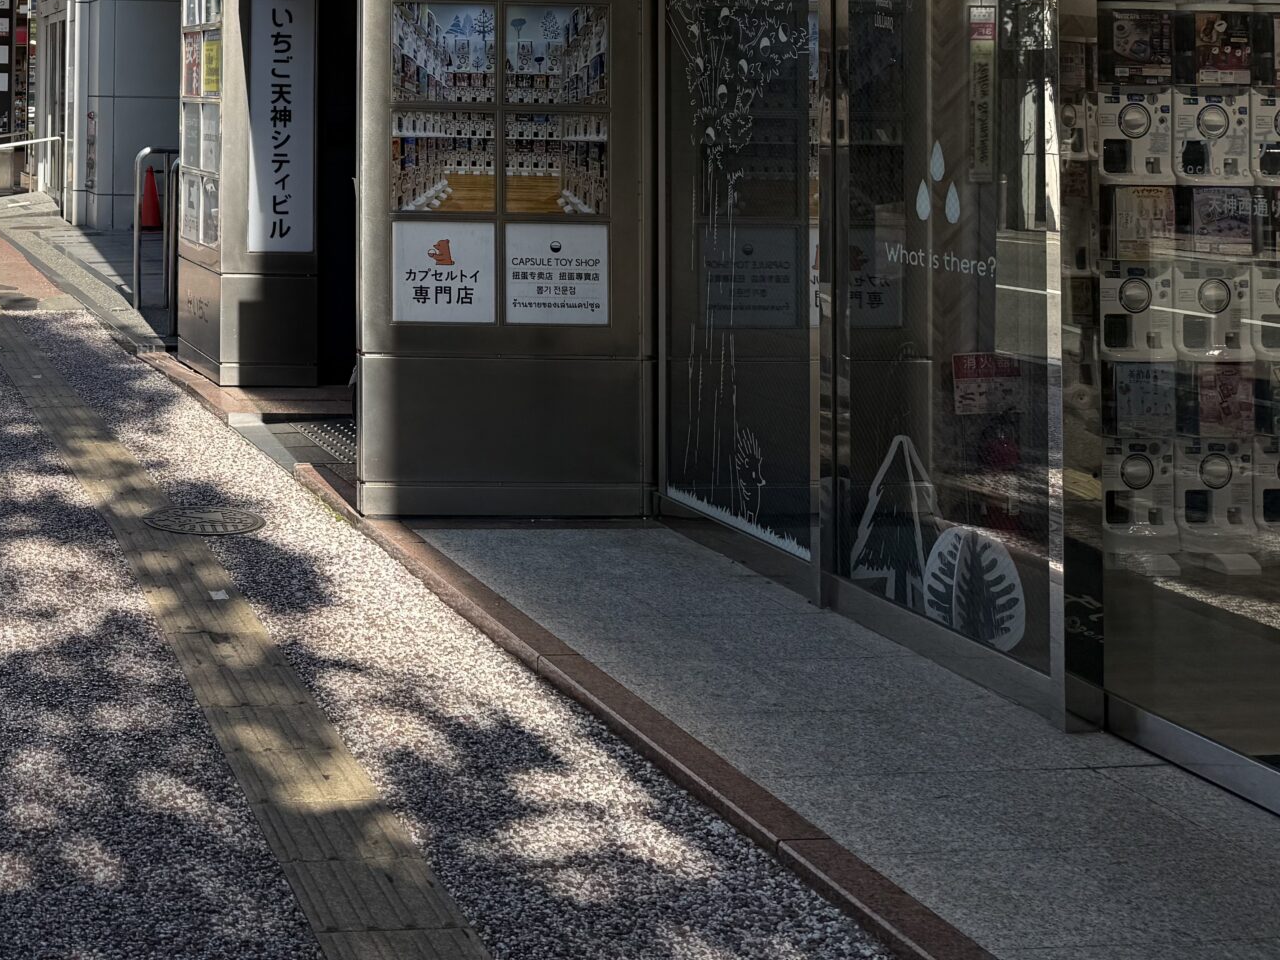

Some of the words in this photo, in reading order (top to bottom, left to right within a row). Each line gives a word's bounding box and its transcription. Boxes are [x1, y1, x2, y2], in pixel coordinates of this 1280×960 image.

[270, 7, 293, 239] いちご天神シティビル
[511, 257, 553, 267] CAPSULE
[554, 258, 573, 267] TOY
[575, 258, 600, 268] SHOP
[885, 242, 924, 266] What
[928, 249, 939, 269] is
[943, 251, 997, 278] there?
[405, 268, 480, 283] カプセルトイ
[412, 285, 474, 305] 専門店
